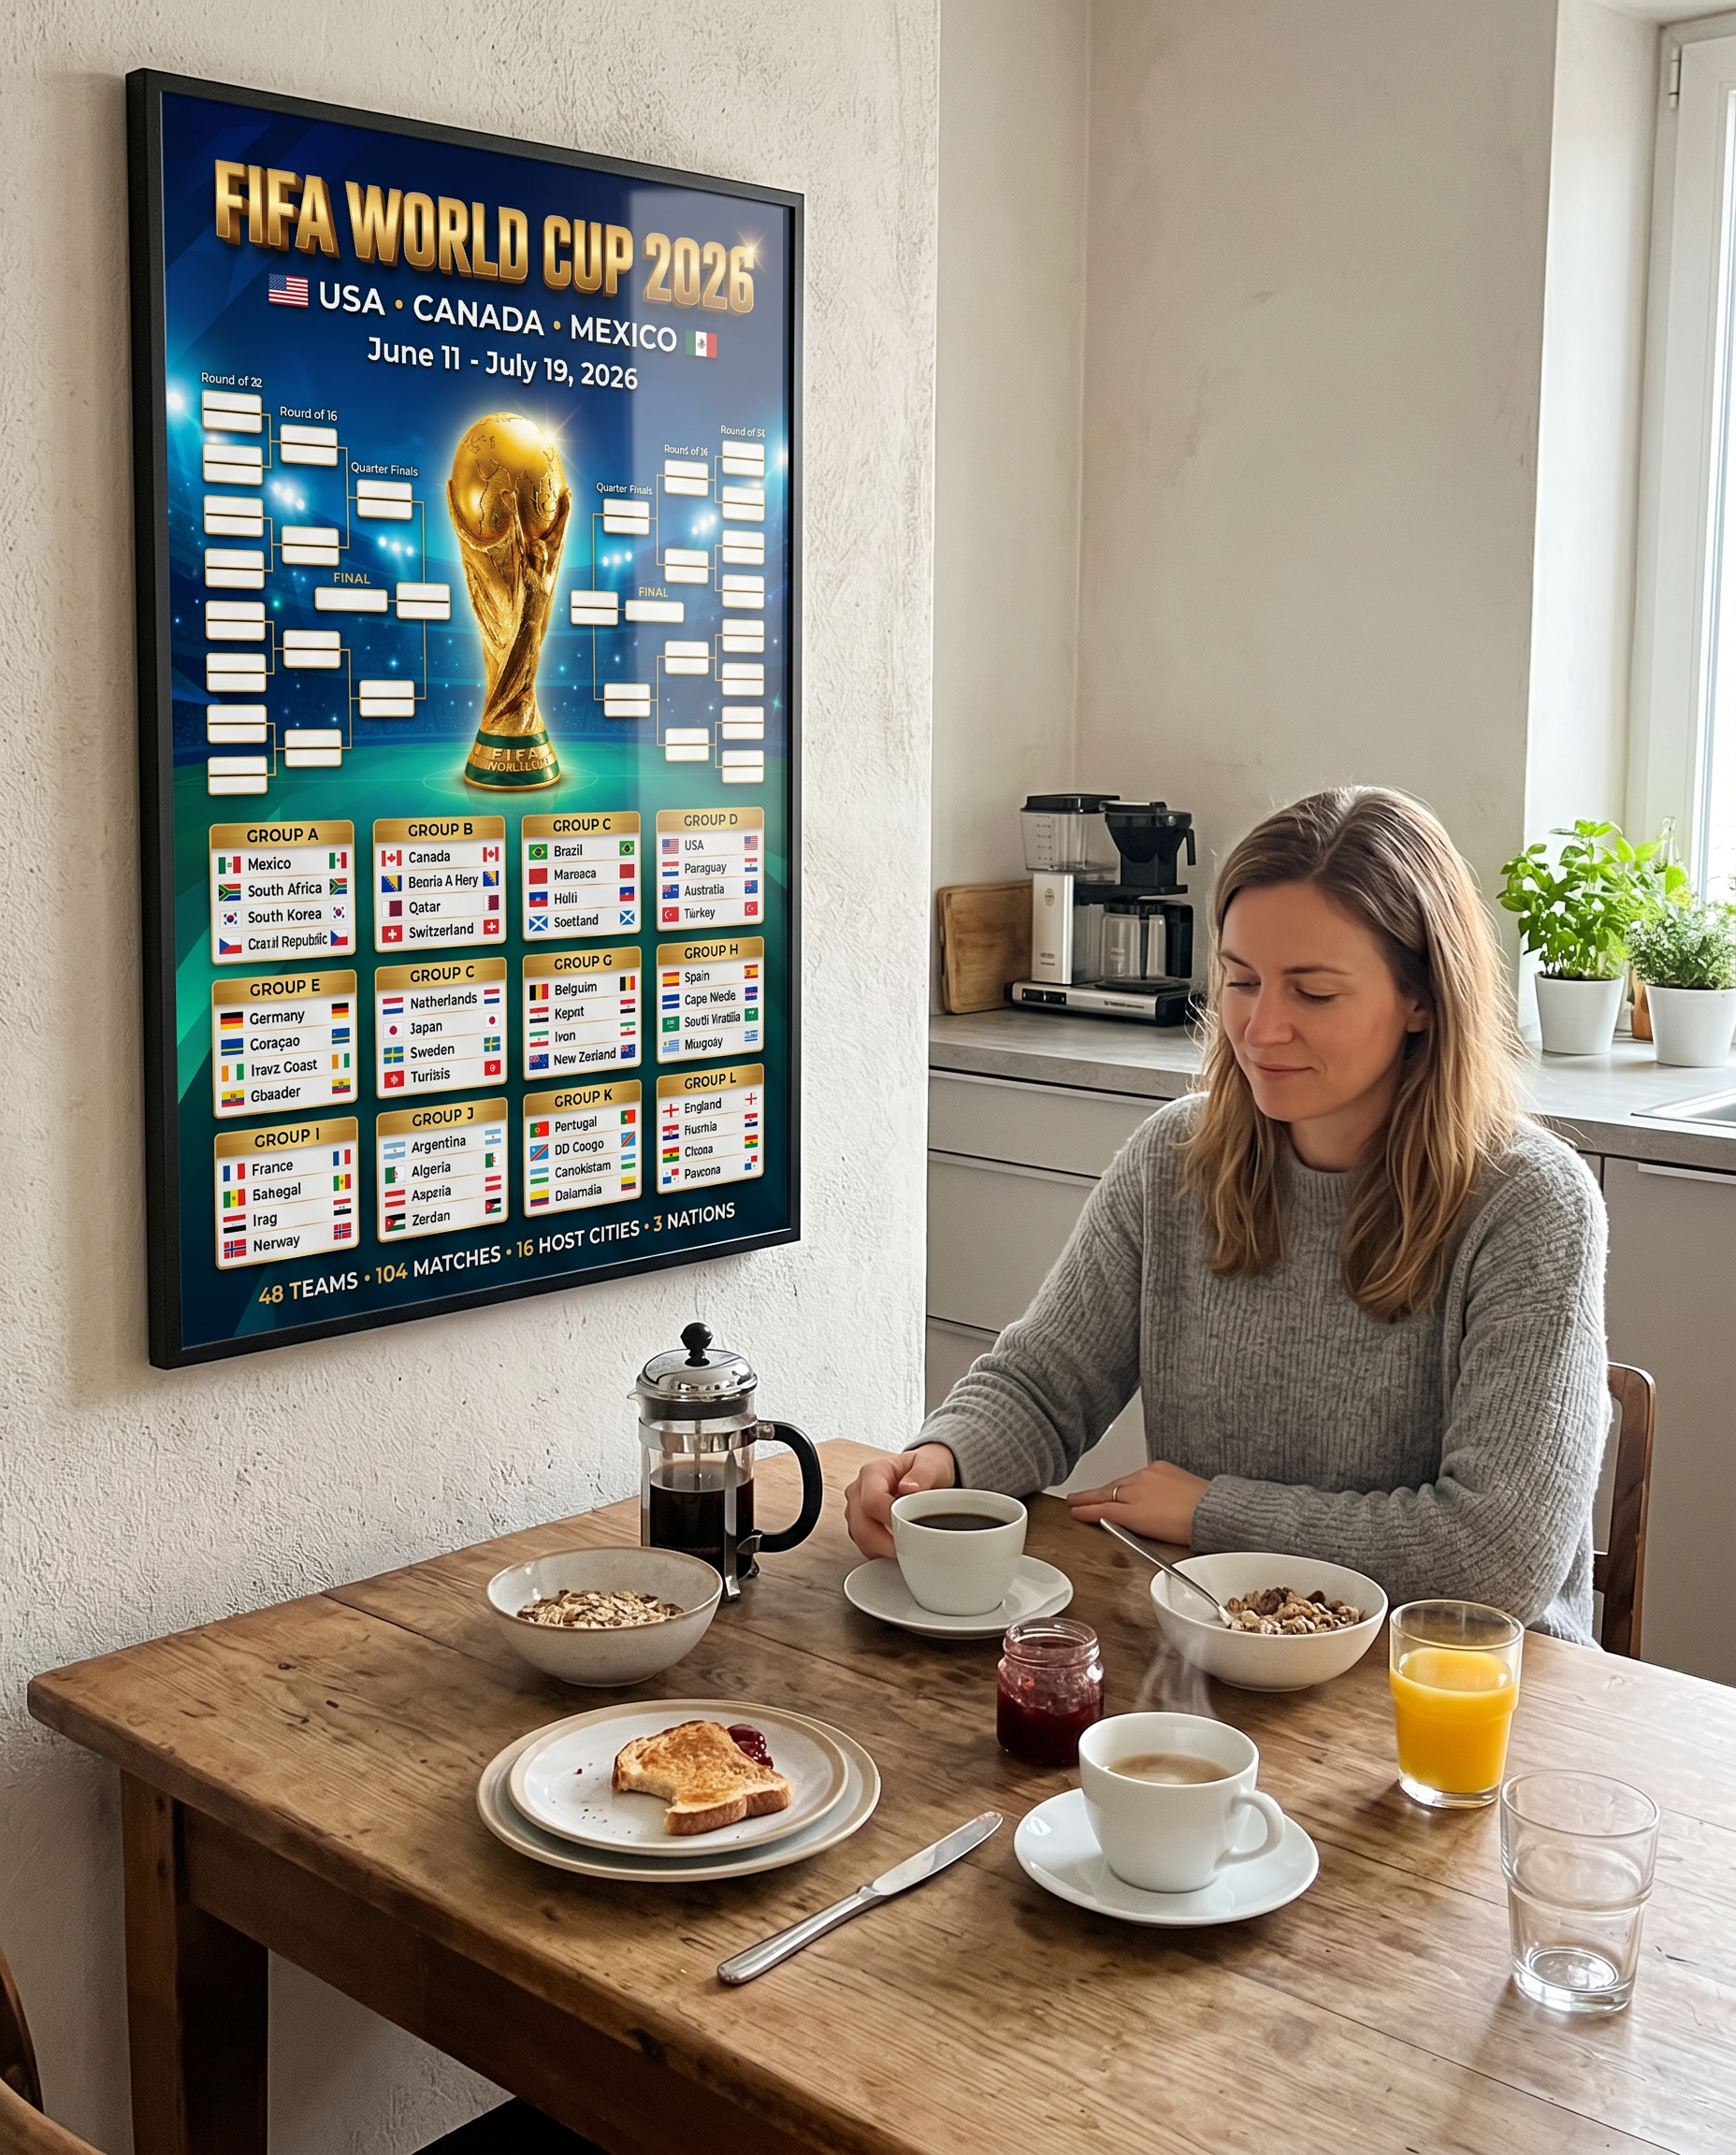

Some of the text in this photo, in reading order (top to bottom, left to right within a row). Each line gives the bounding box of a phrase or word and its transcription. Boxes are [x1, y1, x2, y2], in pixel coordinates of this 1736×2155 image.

[213, 158, 755, 315] FIFA WORLD CUP 2026
[319, 281, 678, 354] USA CANADA MEXICO
[367, 336, 434, 369] June
[441, 343, 461, 370] 11
[485, 352, 537, 384] July
[542, 358, 574, 389] 19,
[581, 362, 639, 390] 2026
[201, 372, 235, 385] Round
[238, 377, 248, 386] of
[314, 410, 326, 420] of
[327, 411, 338, 421] 16
[721, 426, 745, 436] Round
[747, 428, 756, 437] of
[690, 447, 701, 456] of
[351, 462, 418, 477] Quarter Finals
[596, 483, 627, 494] Quarter
[334, 572, 370, 584] FINAL
[639, 587, 668, 597] FINAL
[492, 748, 538, 761] FIFA
[553, 818, 612, 832] GROUP C
[684, 814, 738, 827] GROUP D
[247, 828, 319, 843] GROUP A
[408, 822, 473, 837] GROUP B
[554, 845, 583, 857] Brazil
[685, 840, 703, 851] USA
[409, 850, 451, 863] Canada
[248, 858, 291, 871] Mexico
[685, 862, 727, 875] Paraguay
[444, 874, 453, 887] A
[248, 883, 322, 898] South Africa
[409, 902, 441, 915] Qatar
[248, 910, 322, 924] South Korea
[409, 923, 474, 938] Switzerland
[685, 944, 738, 959] GROUP H
[554, 956, 600, 970] GROUP
[410, 967, 461, 983] GROUP
[685, 971, 710, 983] Spain
[250, 979, 320, 996] GROUP E
[685, 995, 708, 1007] Cape
[250, 1009, 305, 1025] Germany
[410, 1021, 442, 1035] Japan
[411, 1044, 455, 1059] Sweden
[554, 1051, 576, 1065] New
[685, 1072, 736, 1090] GROUP L
[555, 1089, 613, 1107] GROUP K
[685, 1098, 722, 1113] England
[412, 1107, 474, 1126] GROUP J
[254, 1129, 311, 1148] GROUP
[412, 1137, 466, 1153] Argentina
[555, 1144, 571, 1155] DD
[252, 1161, 294, 1176] France
[412, 1163, 451, 1179] Algeria
[253, 1236, 300, 1252] Nerway
[258, 1203, 735, 1305] 48 TEAMS 104 MATCHES 16 HOST CITIES 3 NATIONS
